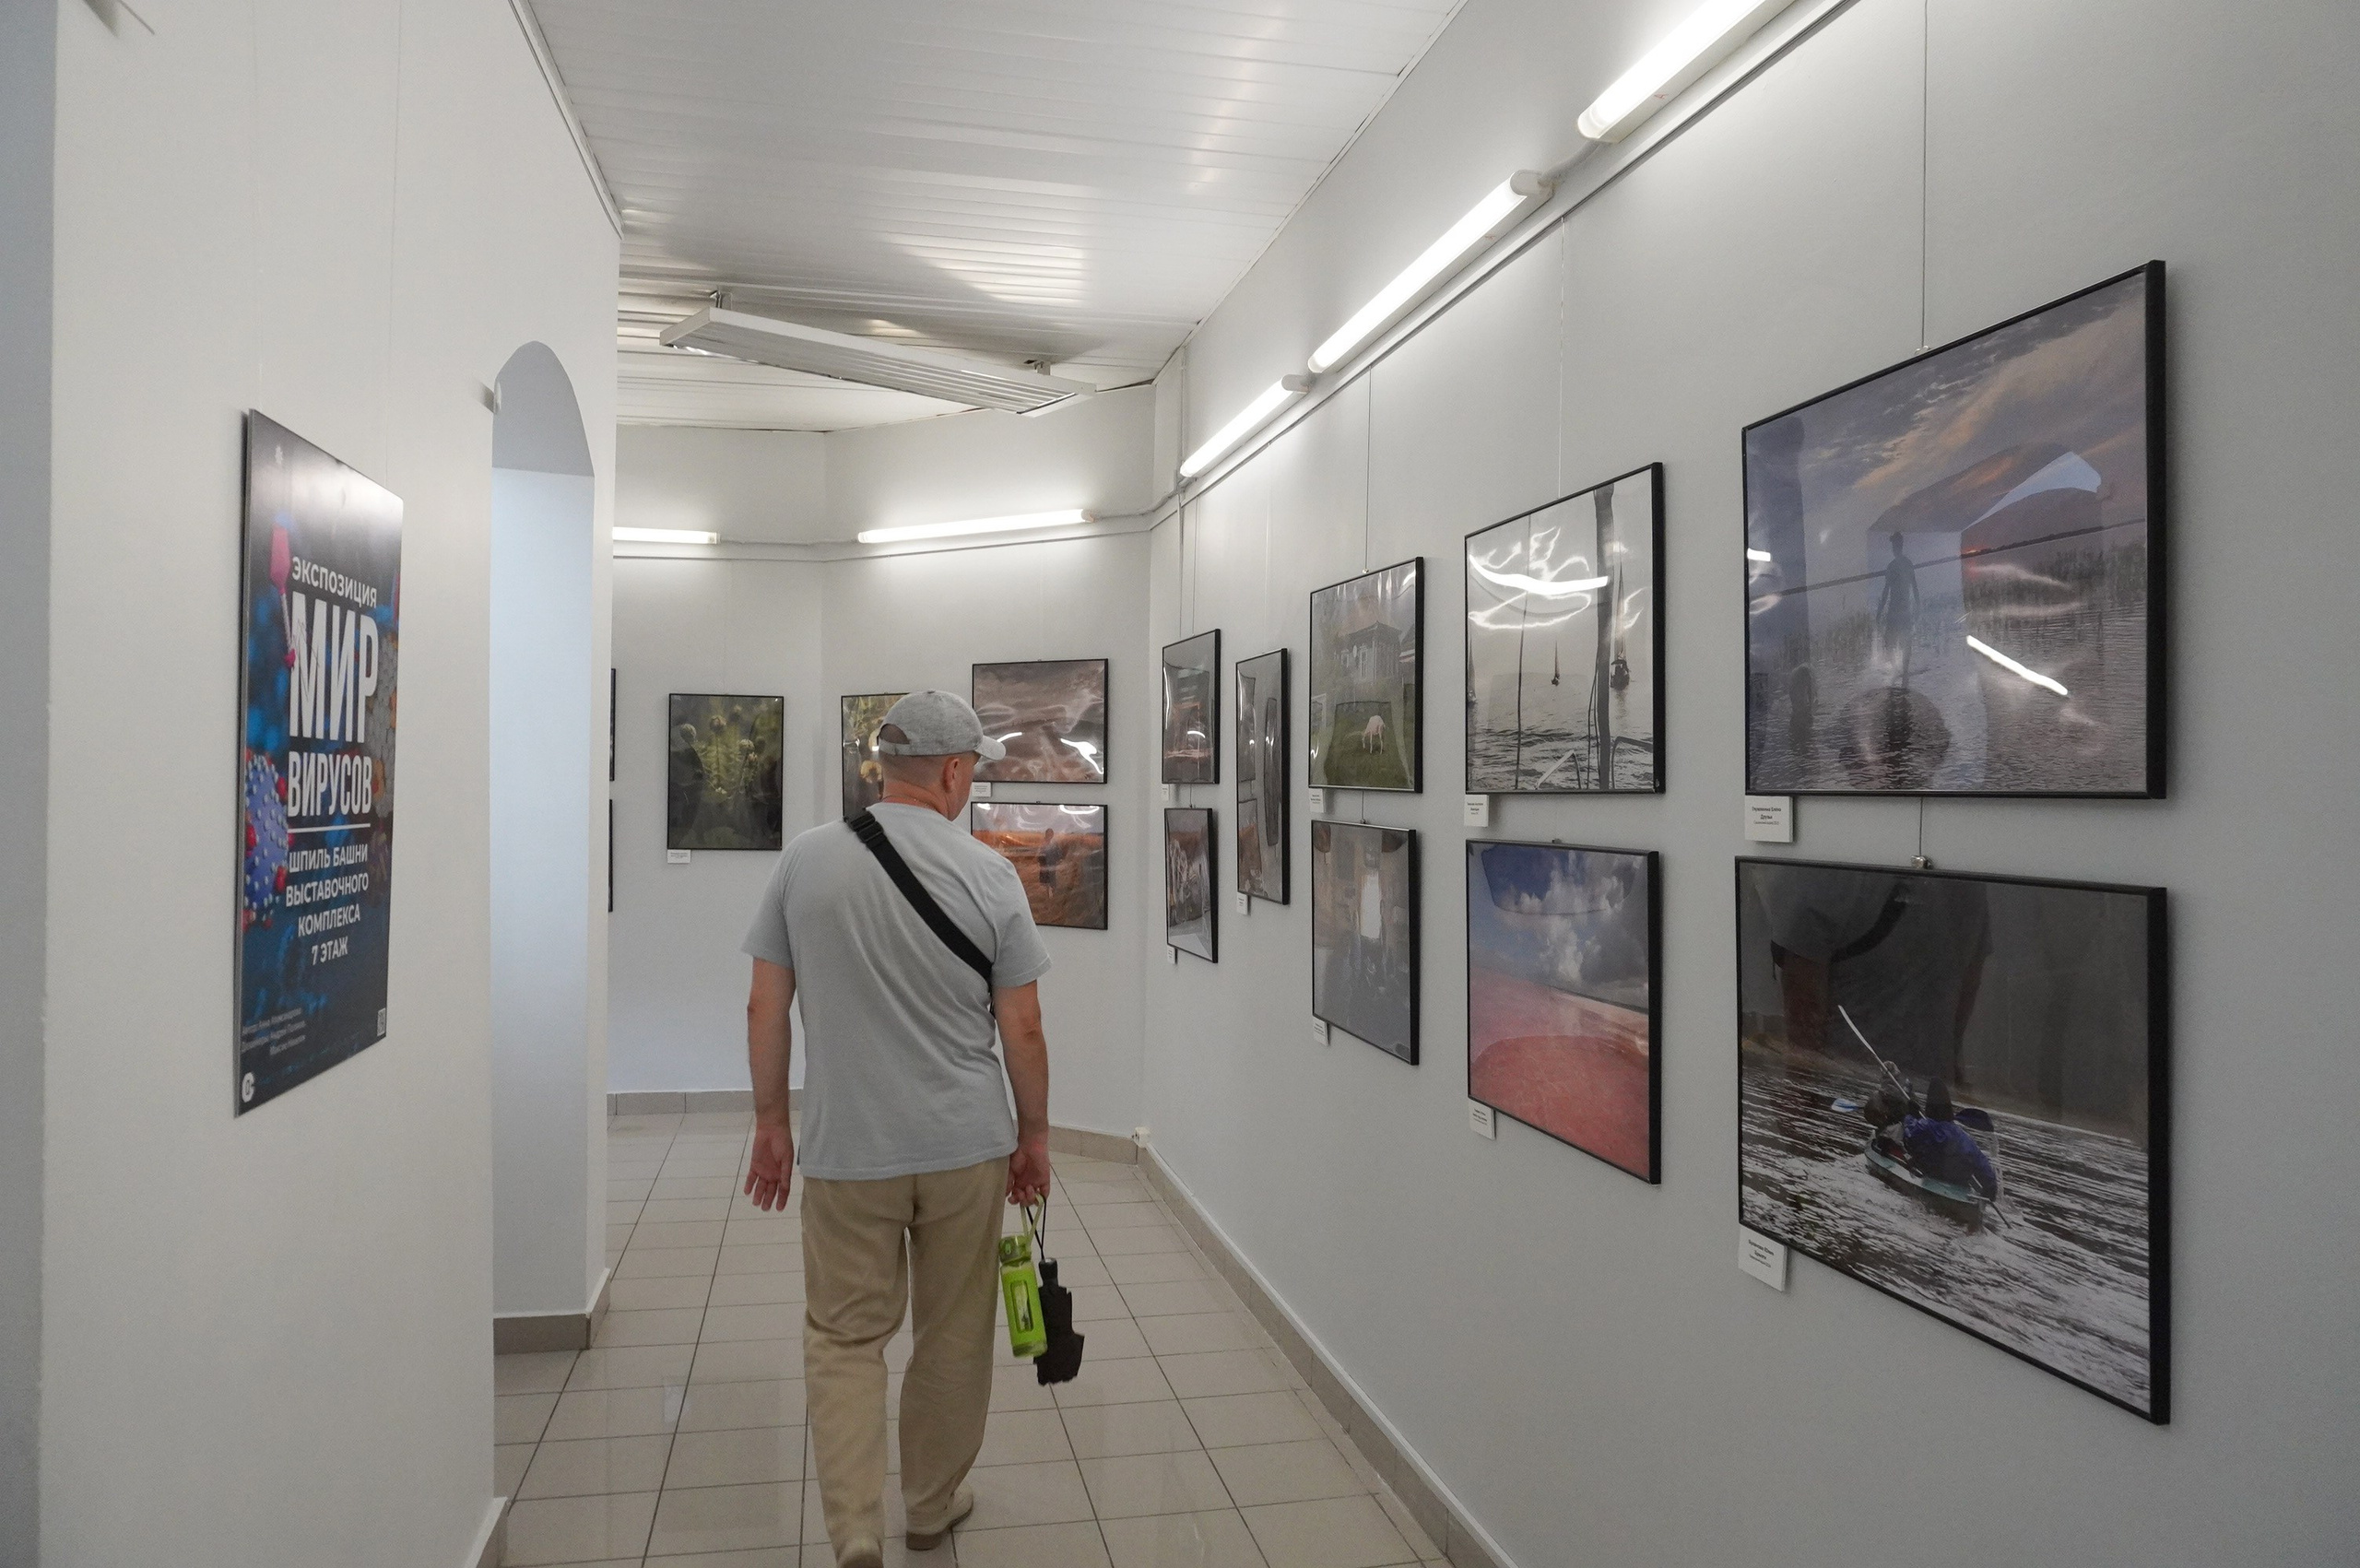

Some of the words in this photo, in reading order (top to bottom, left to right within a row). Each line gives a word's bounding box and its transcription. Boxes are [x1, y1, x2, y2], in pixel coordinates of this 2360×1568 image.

[291, 556, 377, 608] ЭКСПОЗИЦИЯ
[289, 590, 379, 743] МИР
[288, 750, 372, 817] ВИРУСОВ
[289, 850, 330, 873] ШПИЛЬ
[333, 843, 369, 867] БАШНИ
[286, 872, 369, 907] ВЫСТАВОЧНОГО
[298, 903, 360, 937] КОМПЛЕКСА
[311, 944, 318, 965] 7
[320, 936, 348, 963] ЭТАЖ
